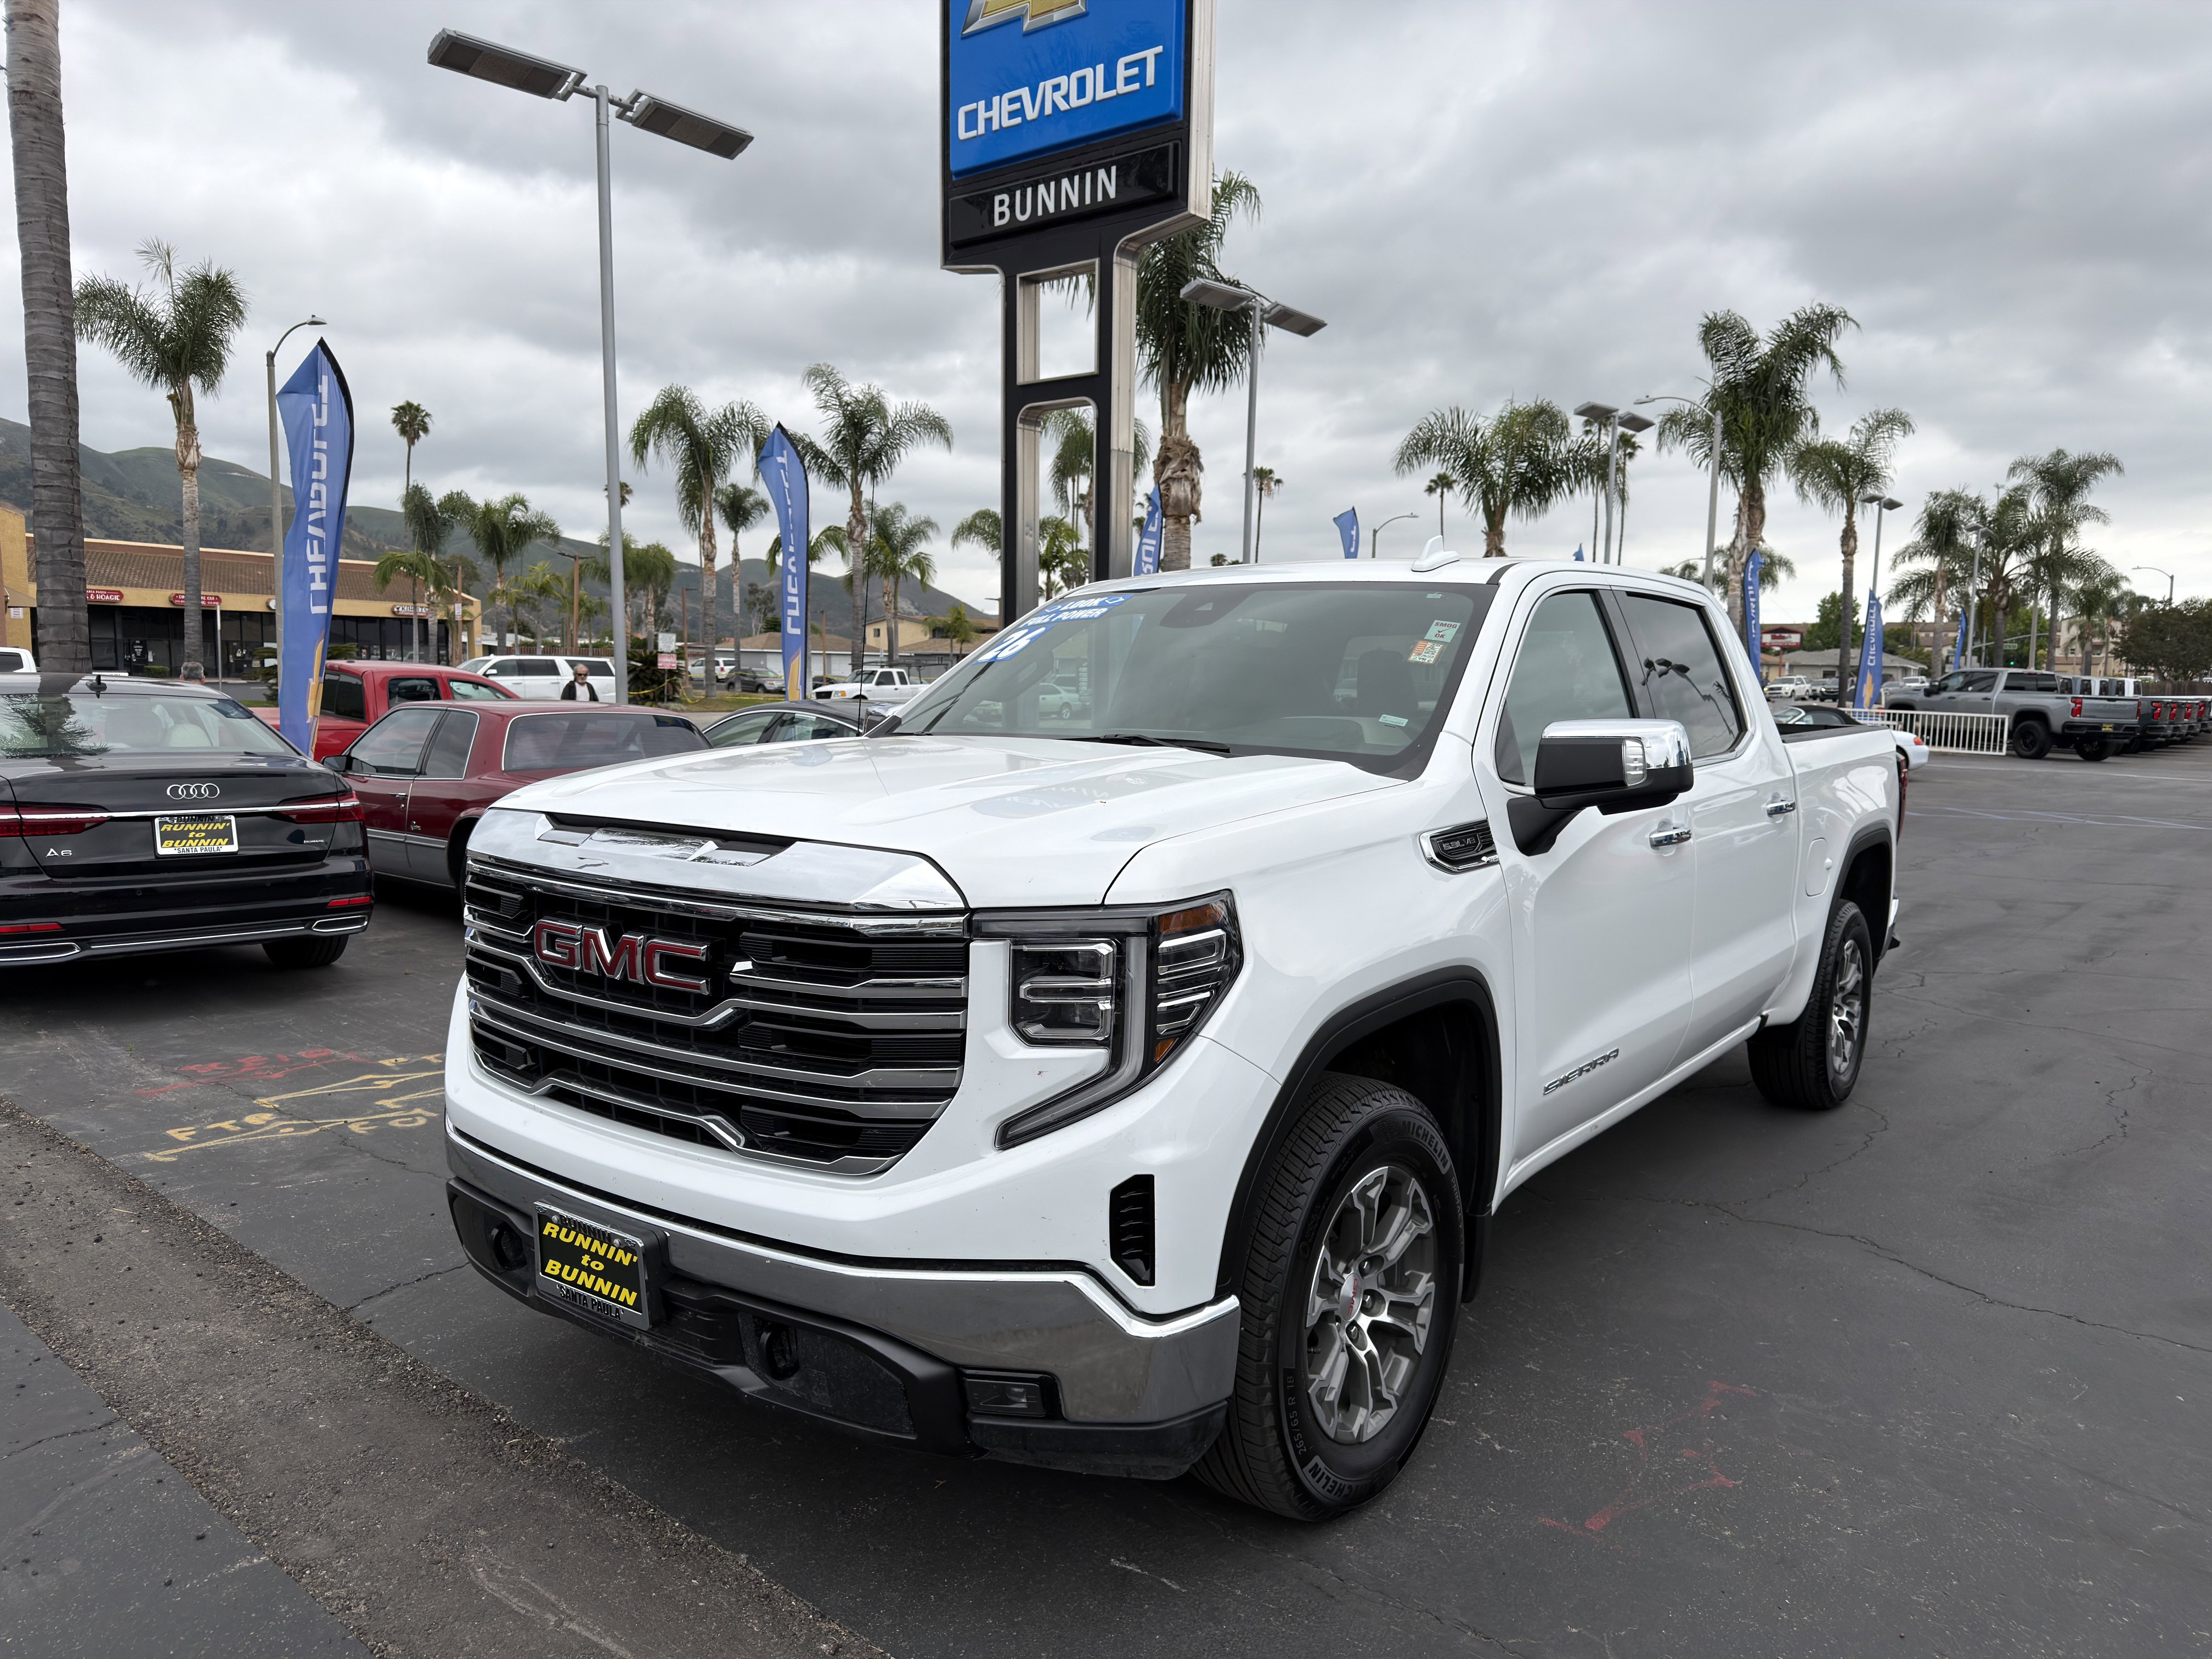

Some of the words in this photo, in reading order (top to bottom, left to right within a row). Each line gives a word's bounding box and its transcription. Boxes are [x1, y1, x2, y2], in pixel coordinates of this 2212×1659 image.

[958, 46, 1163, 140] CHEVROLET
[994, 166, 1116, 227] BUNNIN
[1019, 613, 1056, 628] FULL
[1052, 607, 1109, 622] POWER
[1060, 597, 1108, 611] LOOK
[977, 627, 1046, 662] 26
[161, 823, 230, 831] RUNNIN'
[161, 838, 229, 848] BUNNIN
[534, 919, 711, 995] GMC
[1543, 1048, 1619, 1096] SIERRA
[1402, 1120, 1449, 1169] MICHELIN
[543, 1222, 638, 1266] RUNNIN'
[581, 1254, 605, 1271] to
[545, 1259, 637, 1306] BUNNIN
[1347, 1277, 1359, 1317] GMC
[560, 1284, 589, 1308] SANTA
[591, 1297, 621, 1321] PAULA
[1288, 1396, 1296, 1407] R
